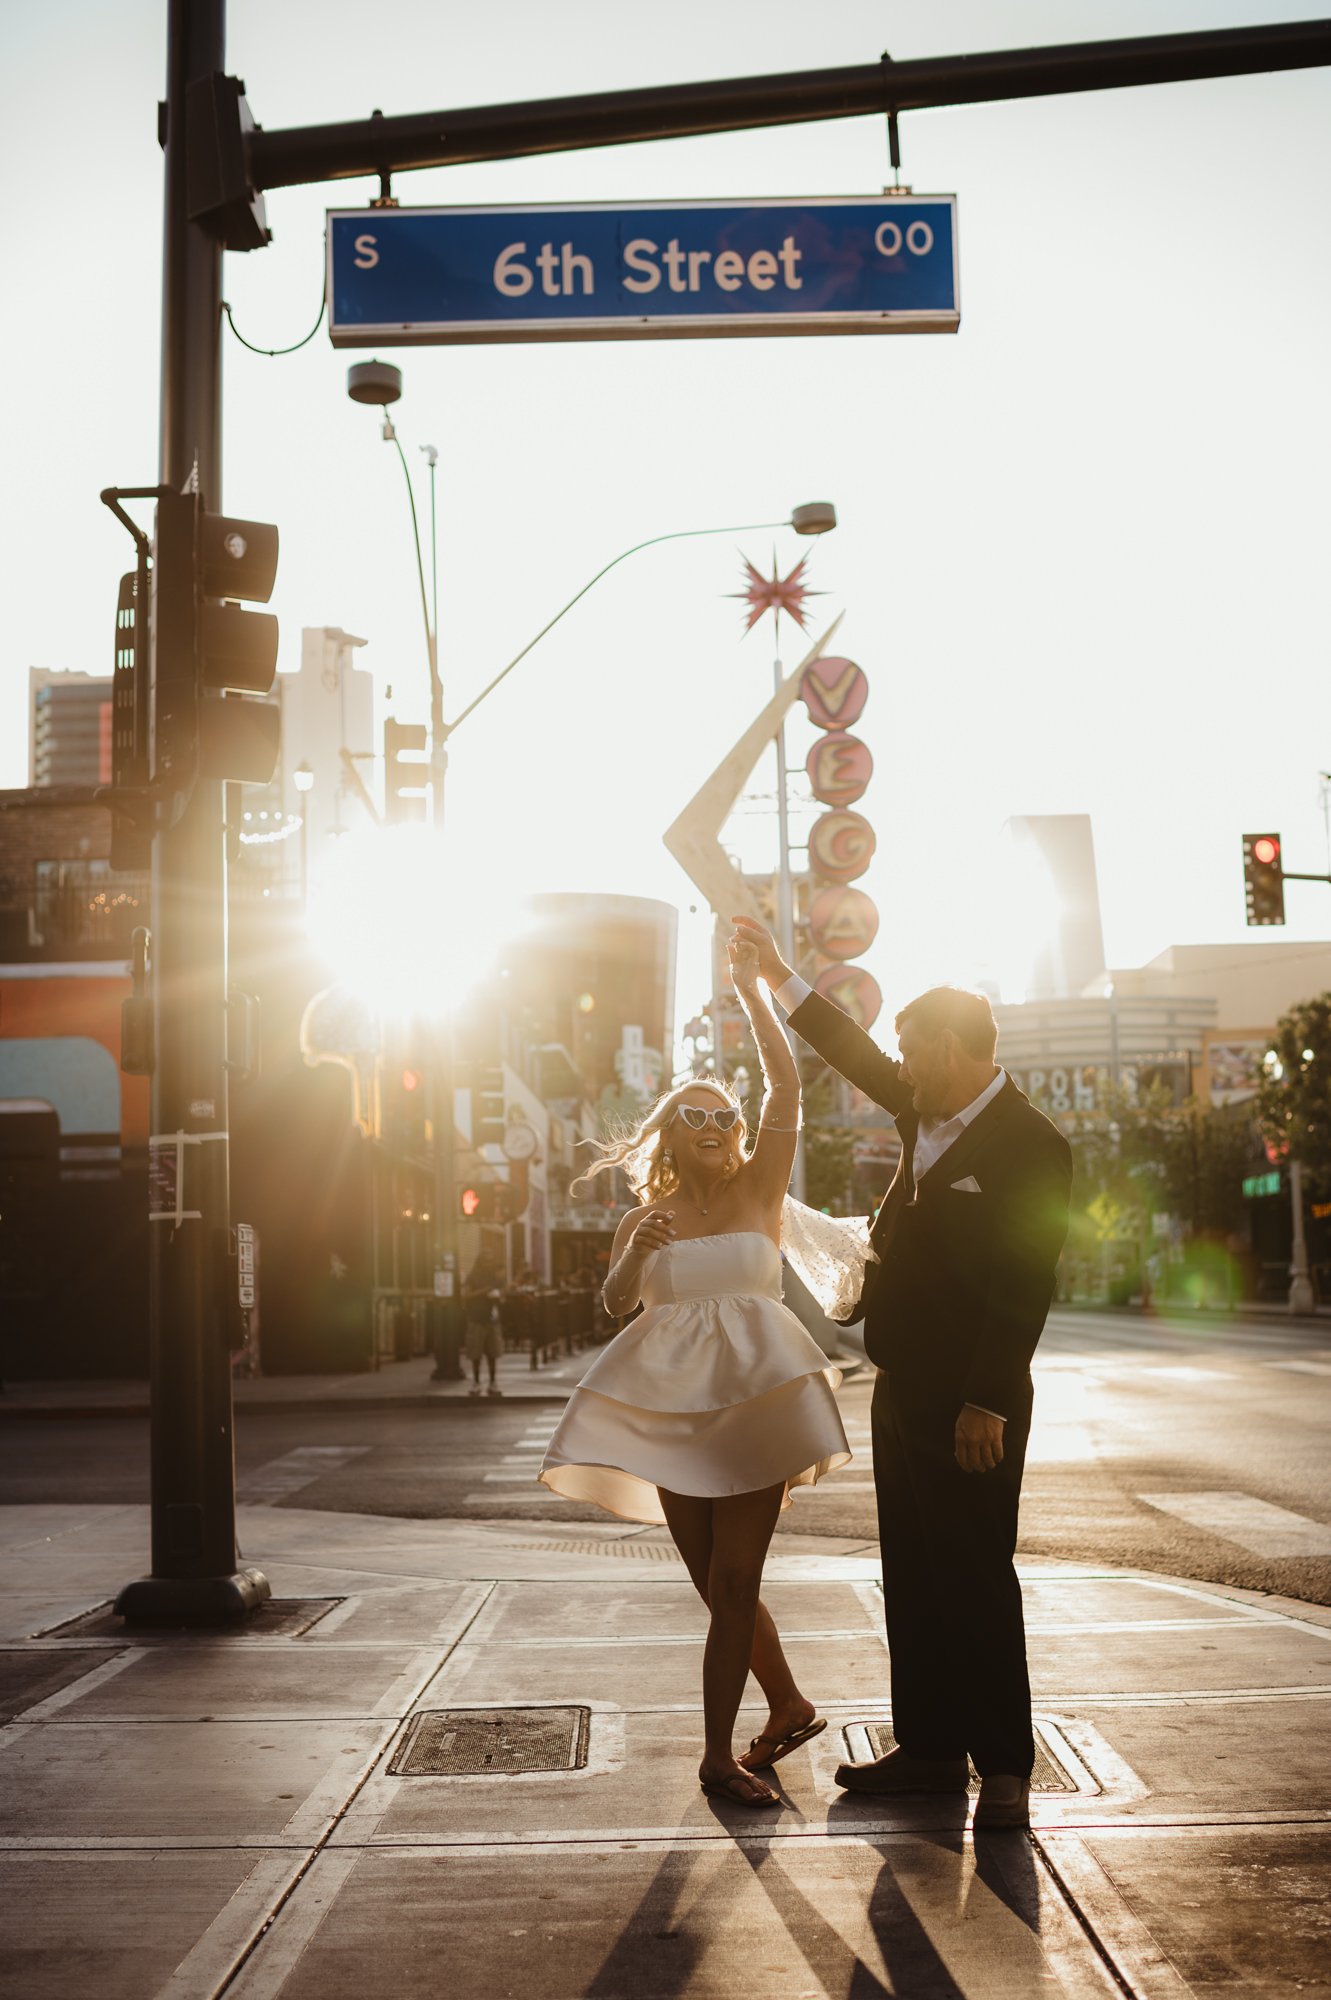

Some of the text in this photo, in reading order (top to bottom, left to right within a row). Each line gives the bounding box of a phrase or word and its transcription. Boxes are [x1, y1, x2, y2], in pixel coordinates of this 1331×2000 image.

[353, 234, 379, 269] S
[493, 242, 595, 297] 6th
[622, 236, 803, 294] Street
